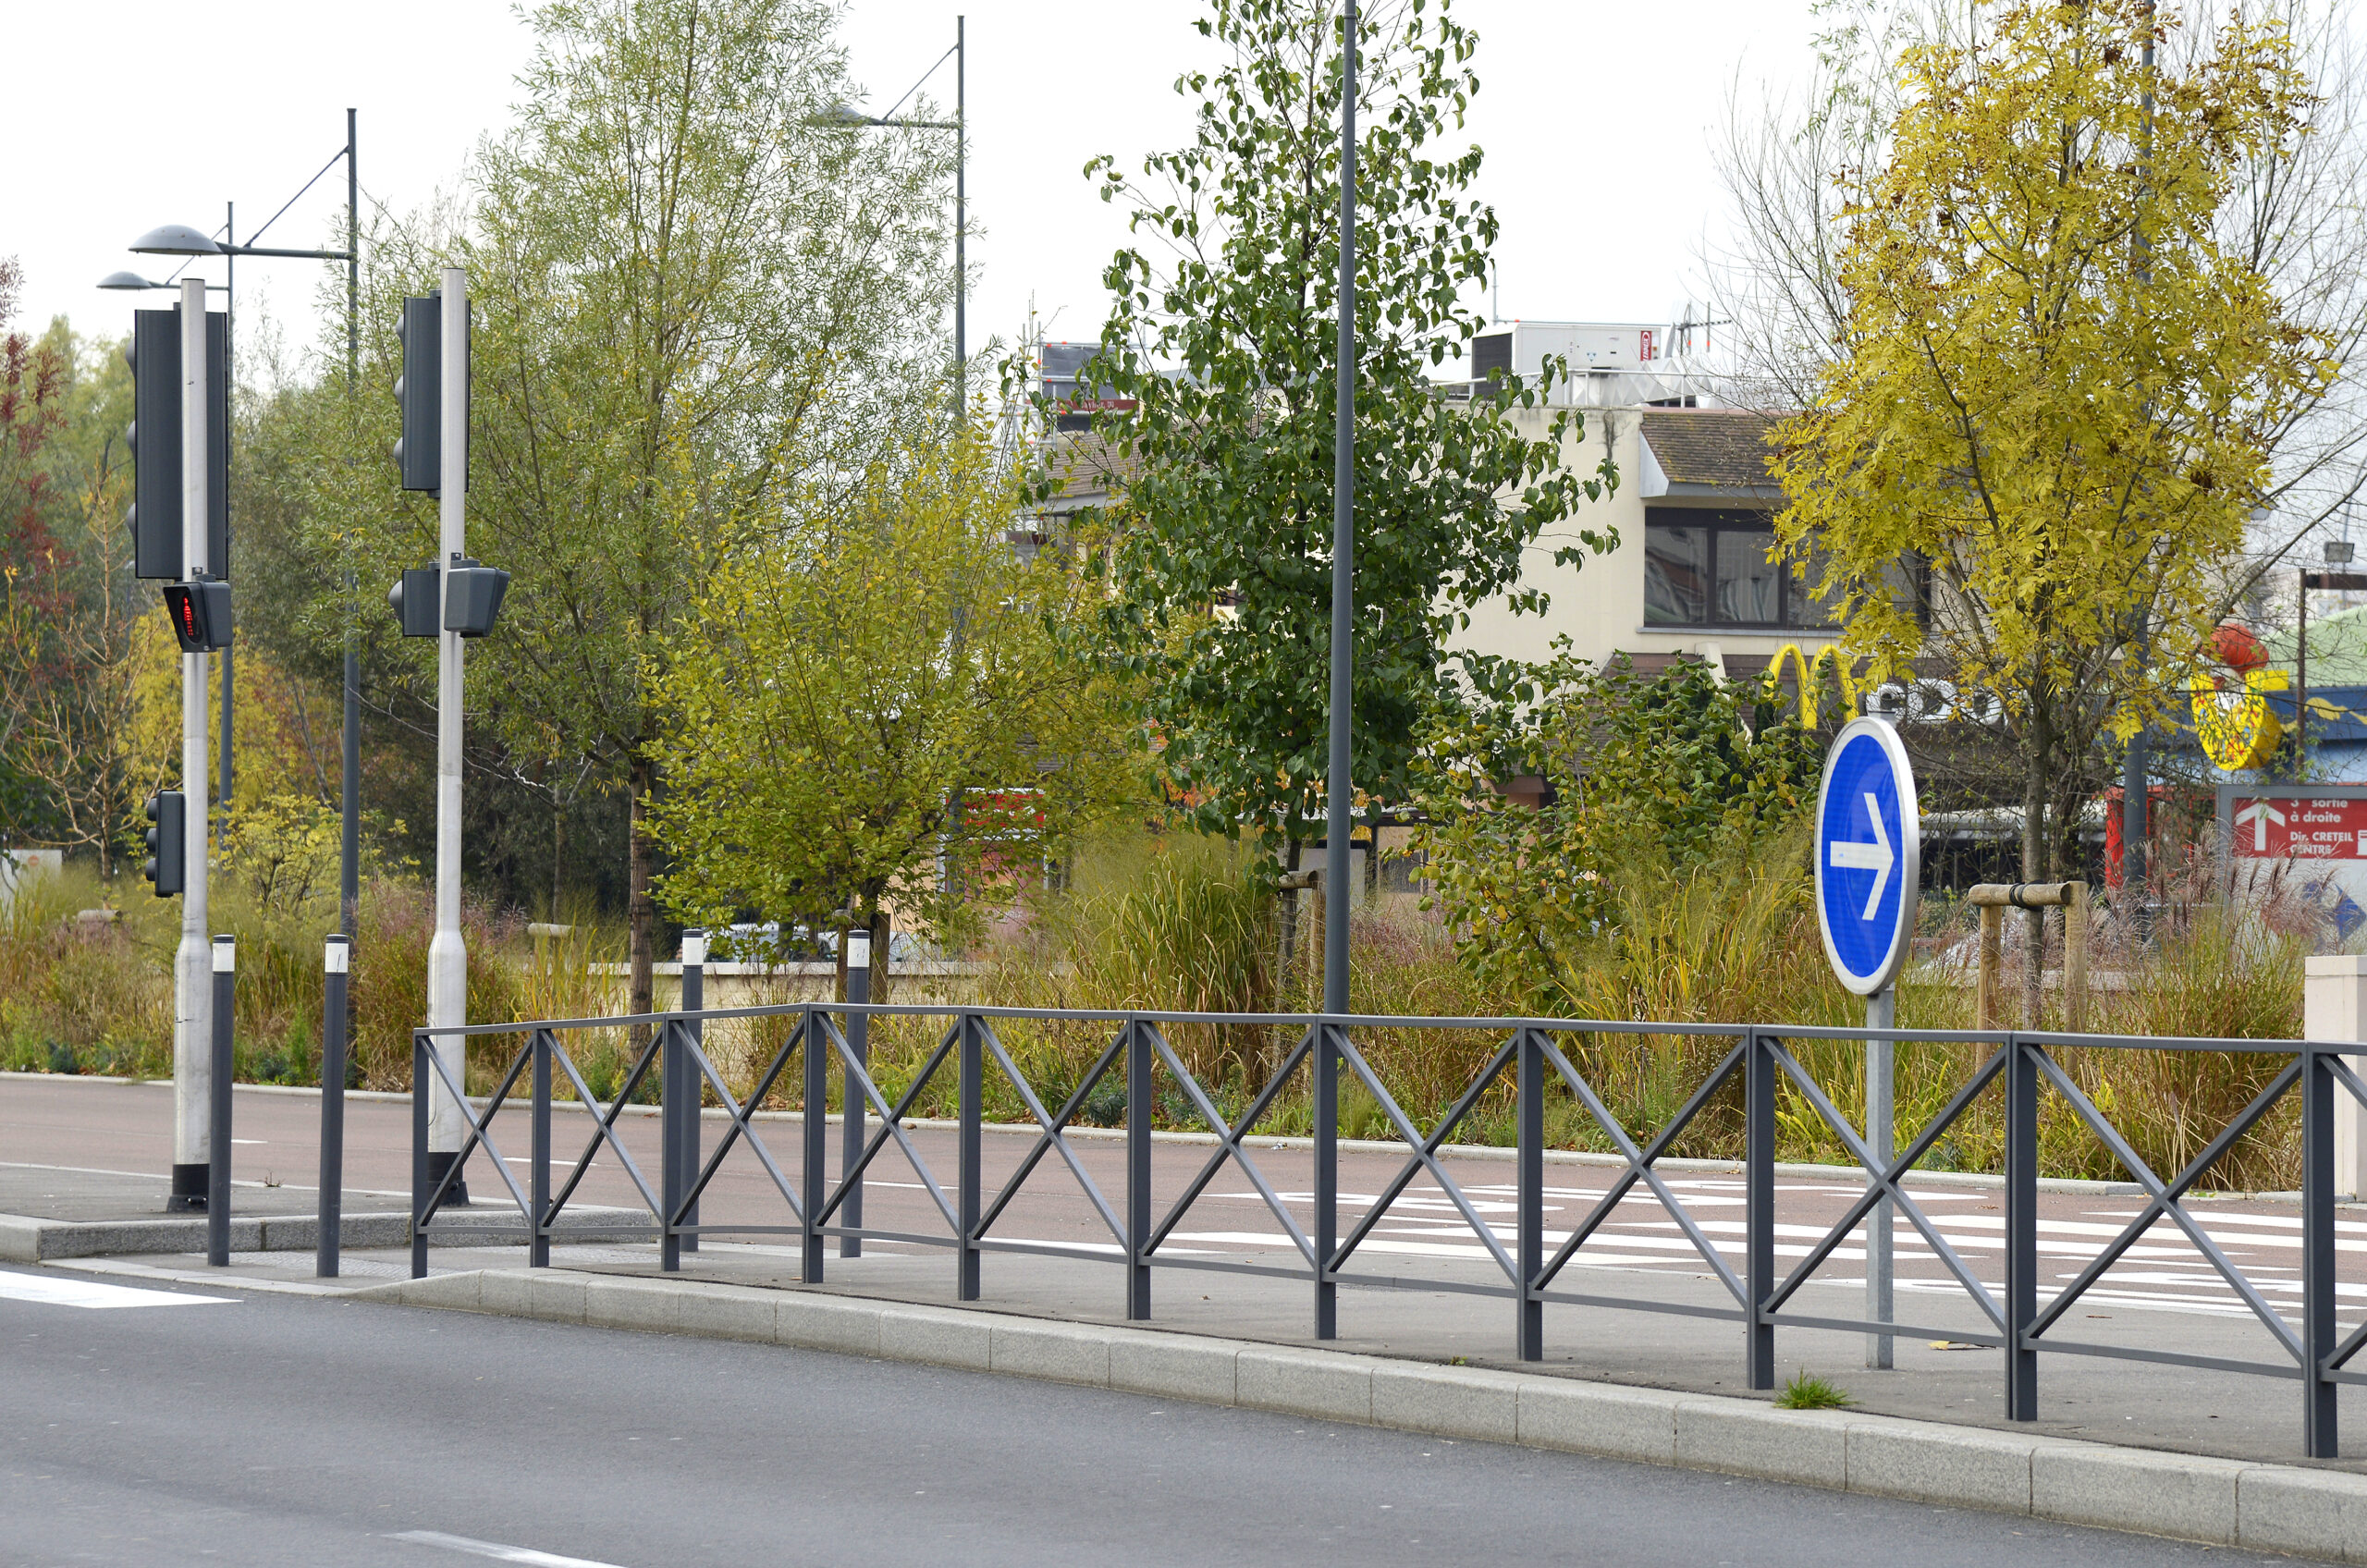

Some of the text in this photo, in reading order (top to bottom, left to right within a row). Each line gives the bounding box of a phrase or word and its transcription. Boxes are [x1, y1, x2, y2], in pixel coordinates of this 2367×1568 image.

[2312, 800, 2349, 808] sortie
[2289, 810, 2341, 823] à droite
[2312, 831, 2354, 843] CRETEIL
